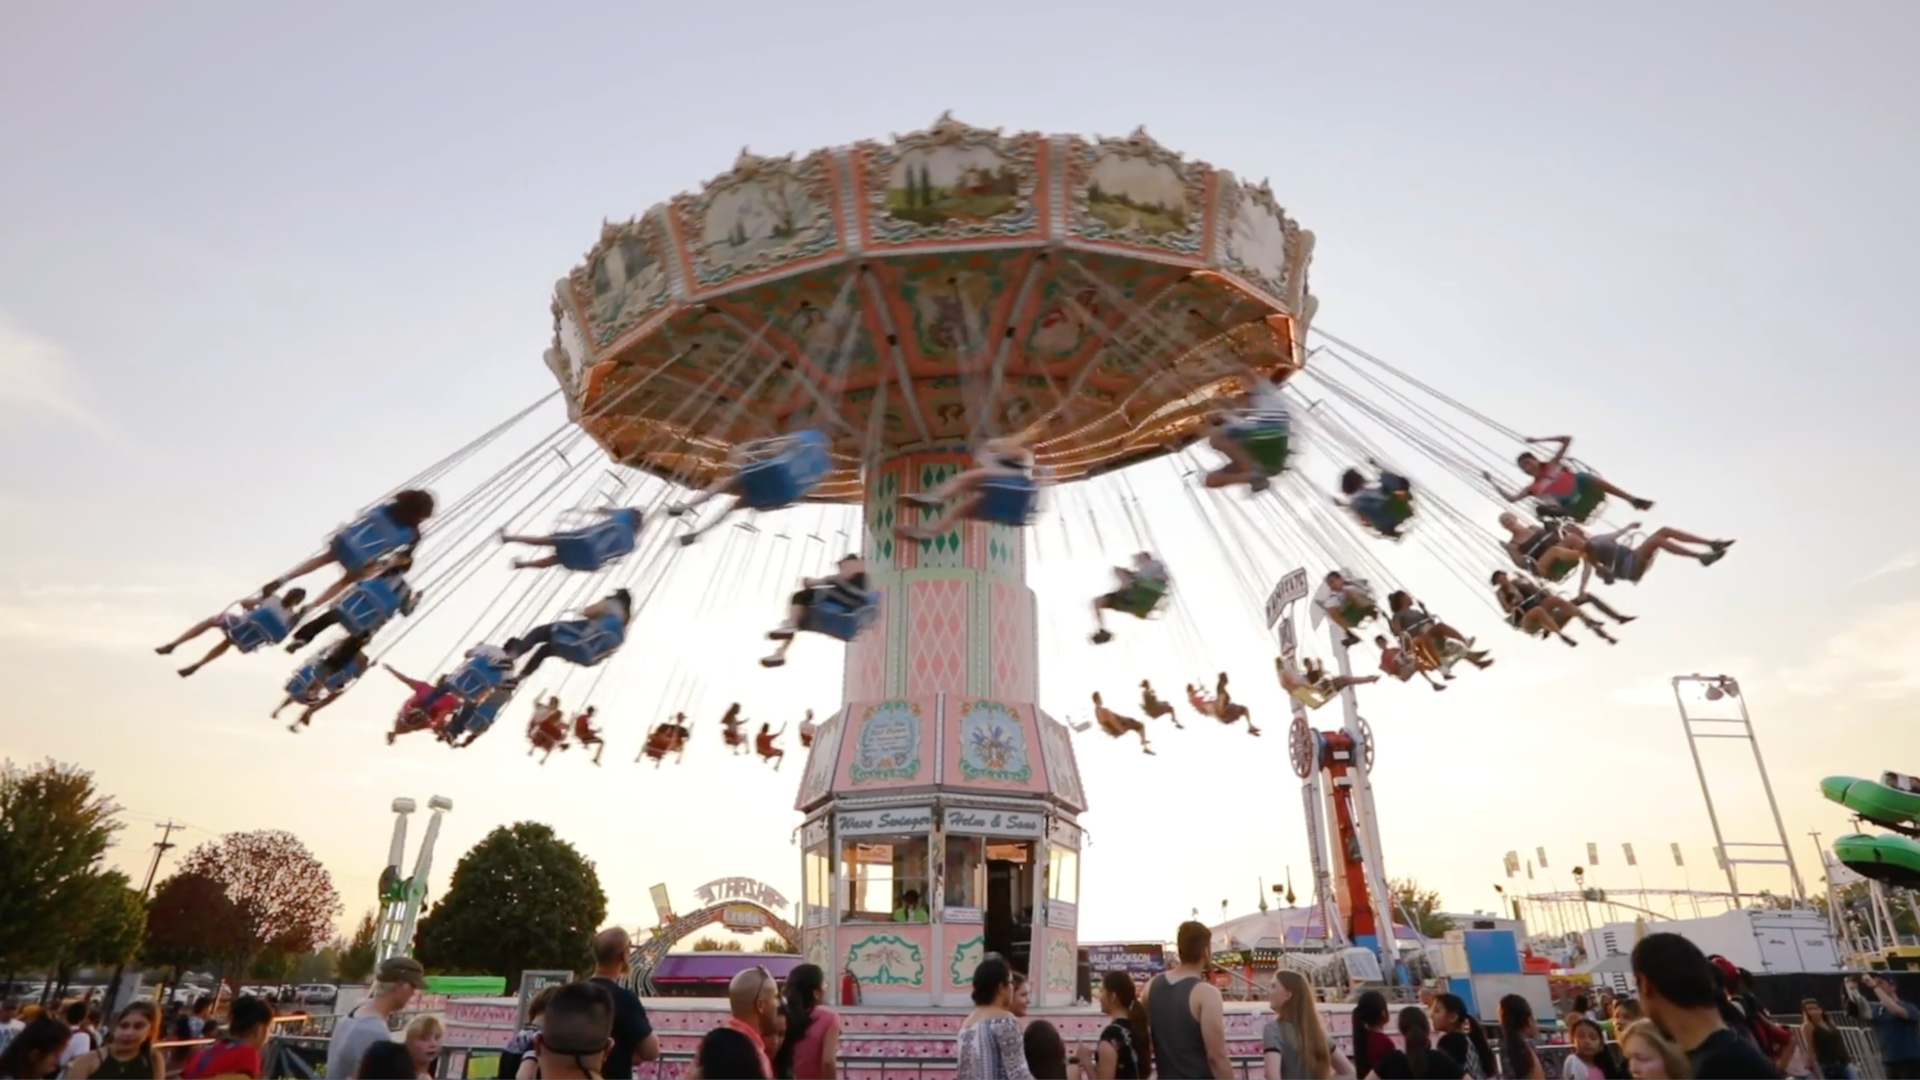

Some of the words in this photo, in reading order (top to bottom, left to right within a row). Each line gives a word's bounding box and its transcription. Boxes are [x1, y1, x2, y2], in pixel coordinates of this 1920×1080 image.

[838, 815, 873, 830] Wave
[878, 813, 931, 831] Swinger
[949, 812, 986, 827] Helm
[990, 814, 1001, 828] &
[1005, 815, 1037, 830] Sons
[1110, 953, 1151, 963] JACKSON
[1129, 972, 1151, 980] ANCH
